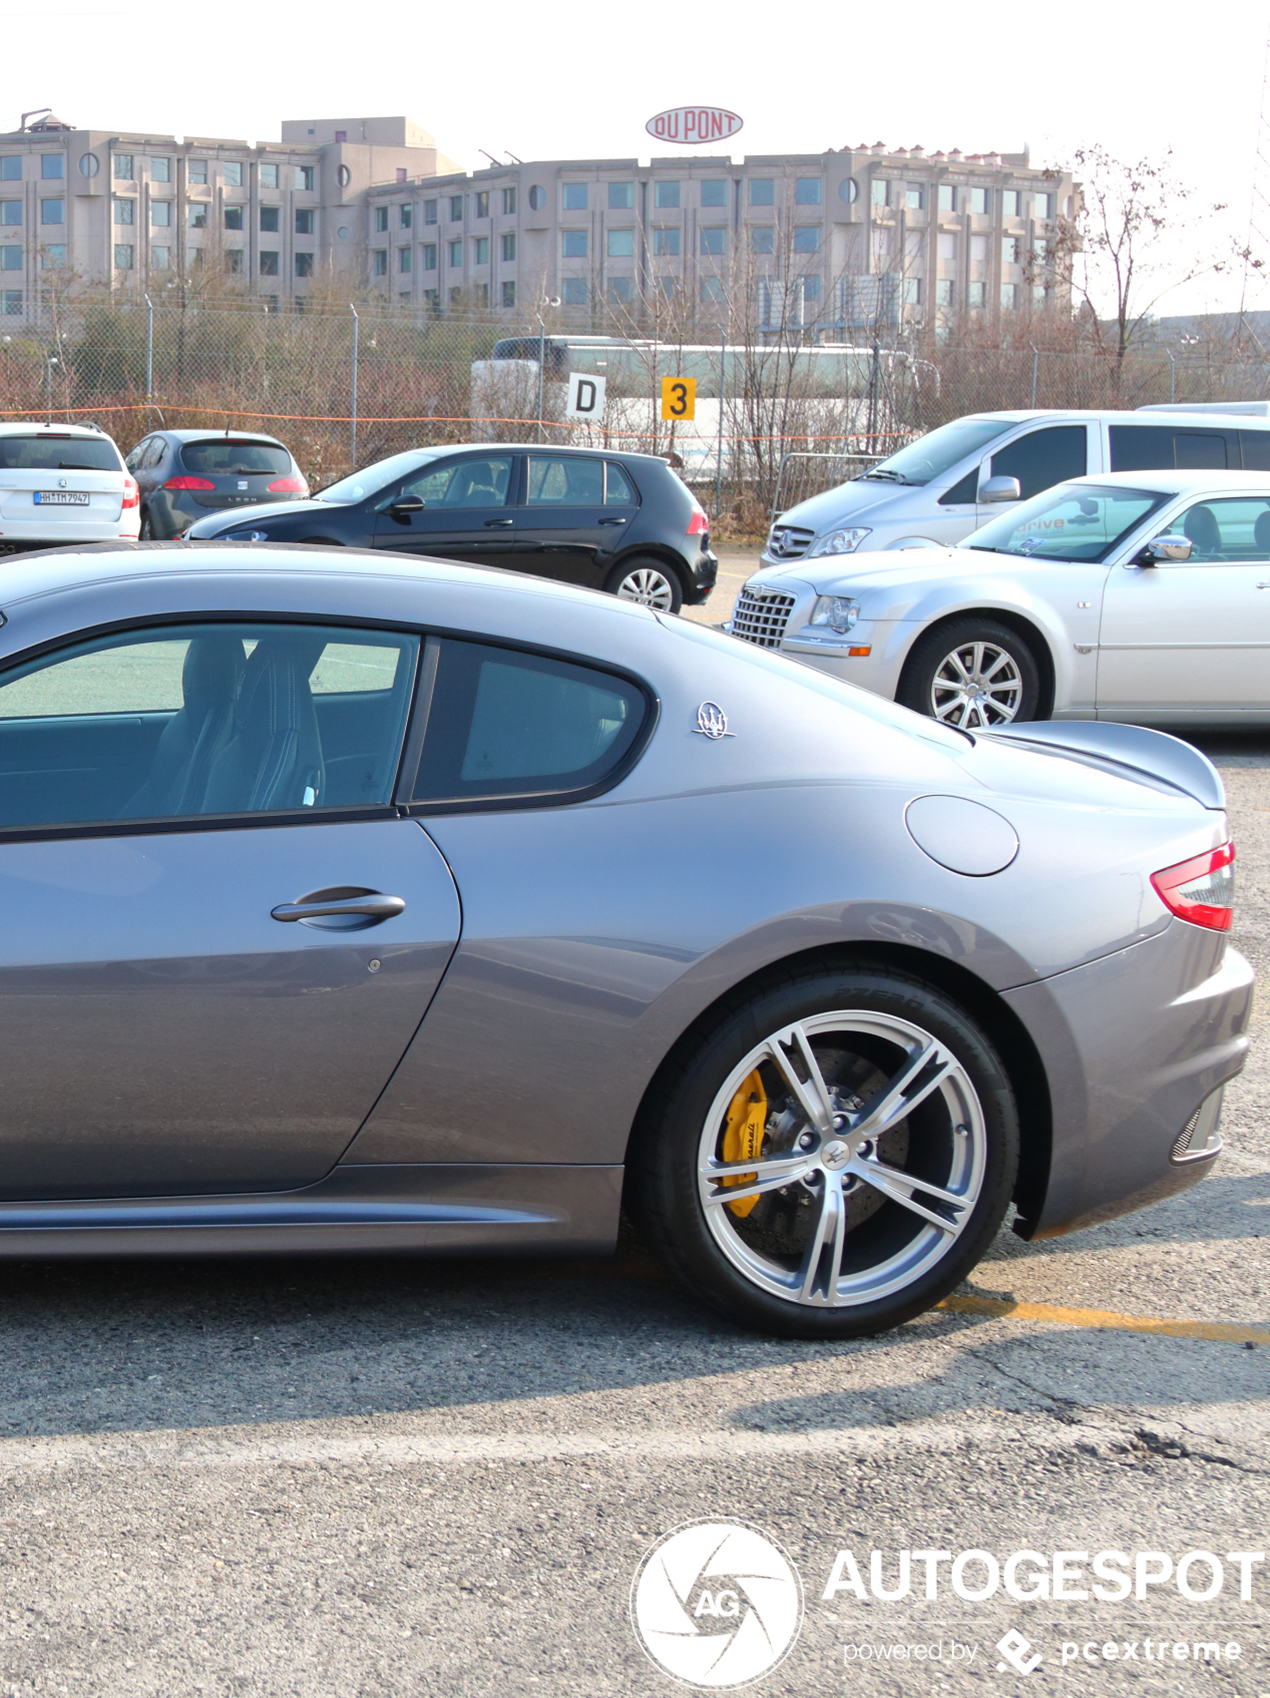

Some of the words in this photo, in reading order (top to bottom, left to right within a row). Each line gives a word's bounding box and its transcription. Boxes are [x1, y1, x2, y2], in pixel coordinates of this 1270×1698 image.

[655, 112, 678, 139] DU
[684, 110, 736, 140] PONT
[576, 379, 597, 412] D
[670, 383, 688, 415] 3
